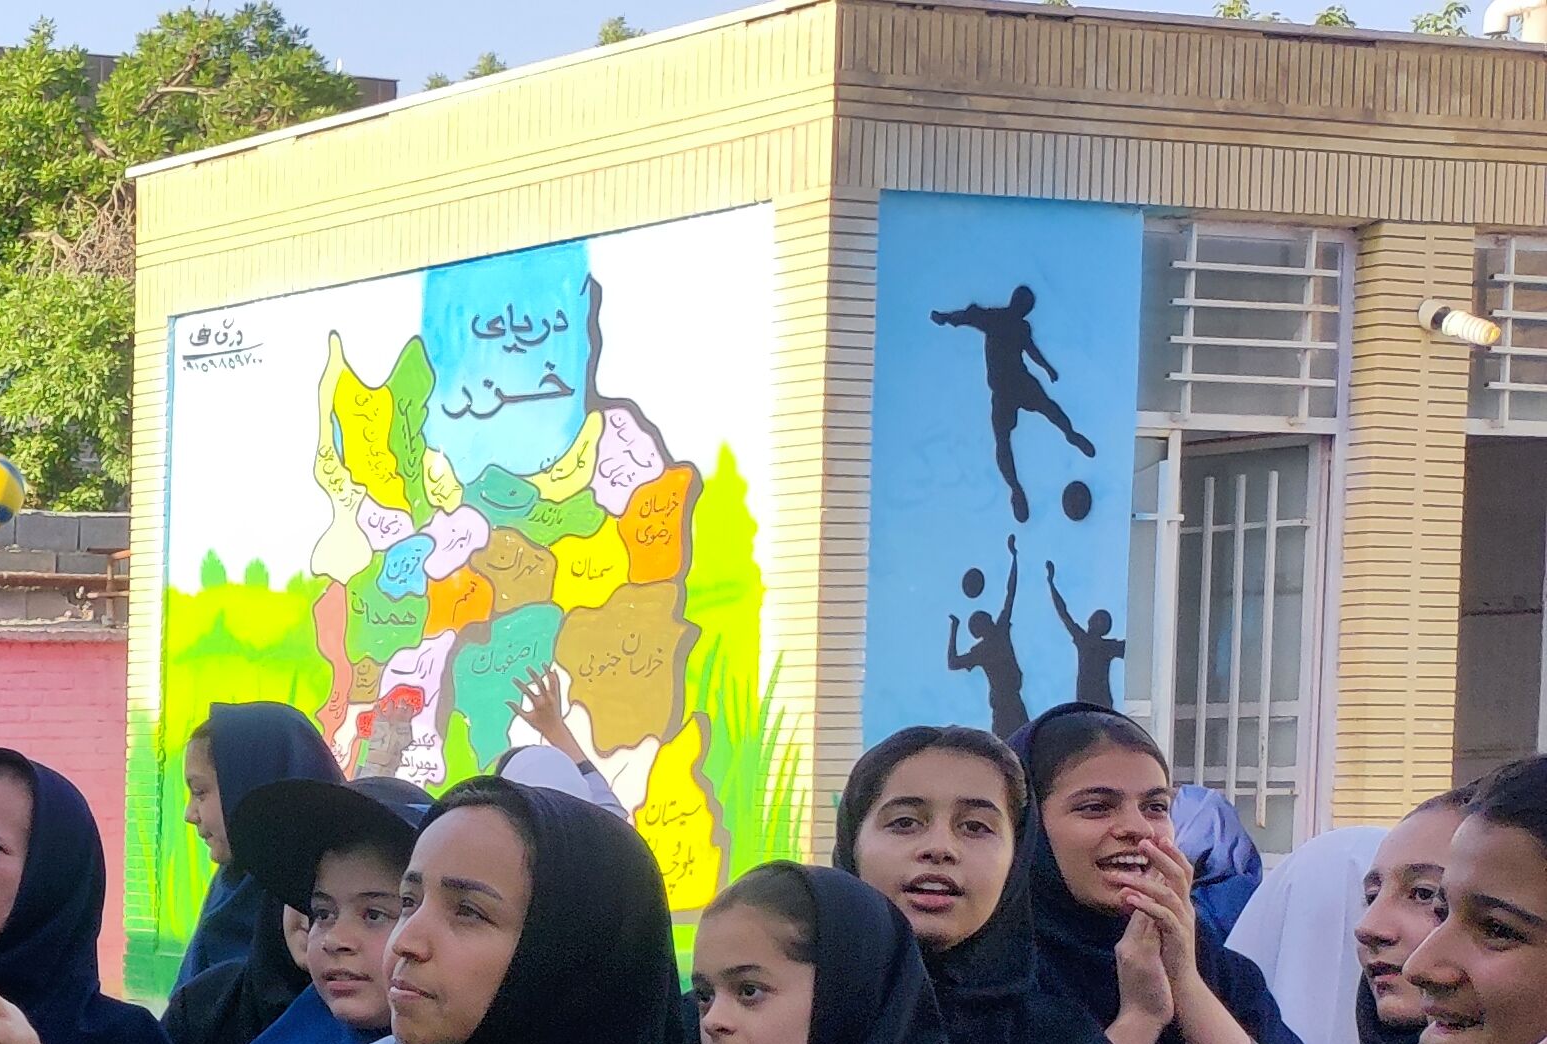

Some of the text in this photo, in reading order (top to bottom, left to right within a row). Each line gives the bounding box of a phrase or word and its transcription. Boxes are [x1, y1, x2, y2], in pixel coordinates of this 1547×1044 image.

[471, 303, 569, 353] دریای
[441, 361, 576, 419] خزر
[640, 492, 679, 518] خراسان
[368, 512, 403, 538] زنجان
[636, 521, 672, 546] رضوی
[486, 547, 543, 582] تهران
[571, 558, 614, 580] سمنان
[351, 591, 417, 624] همدان
[390, 647, 435, 679] اراک
[471, 640, 539, 674] اصفهان
[578, 633, 663, 682] خراسان جنوبی
[645, 800, 702, 826] سیستان
